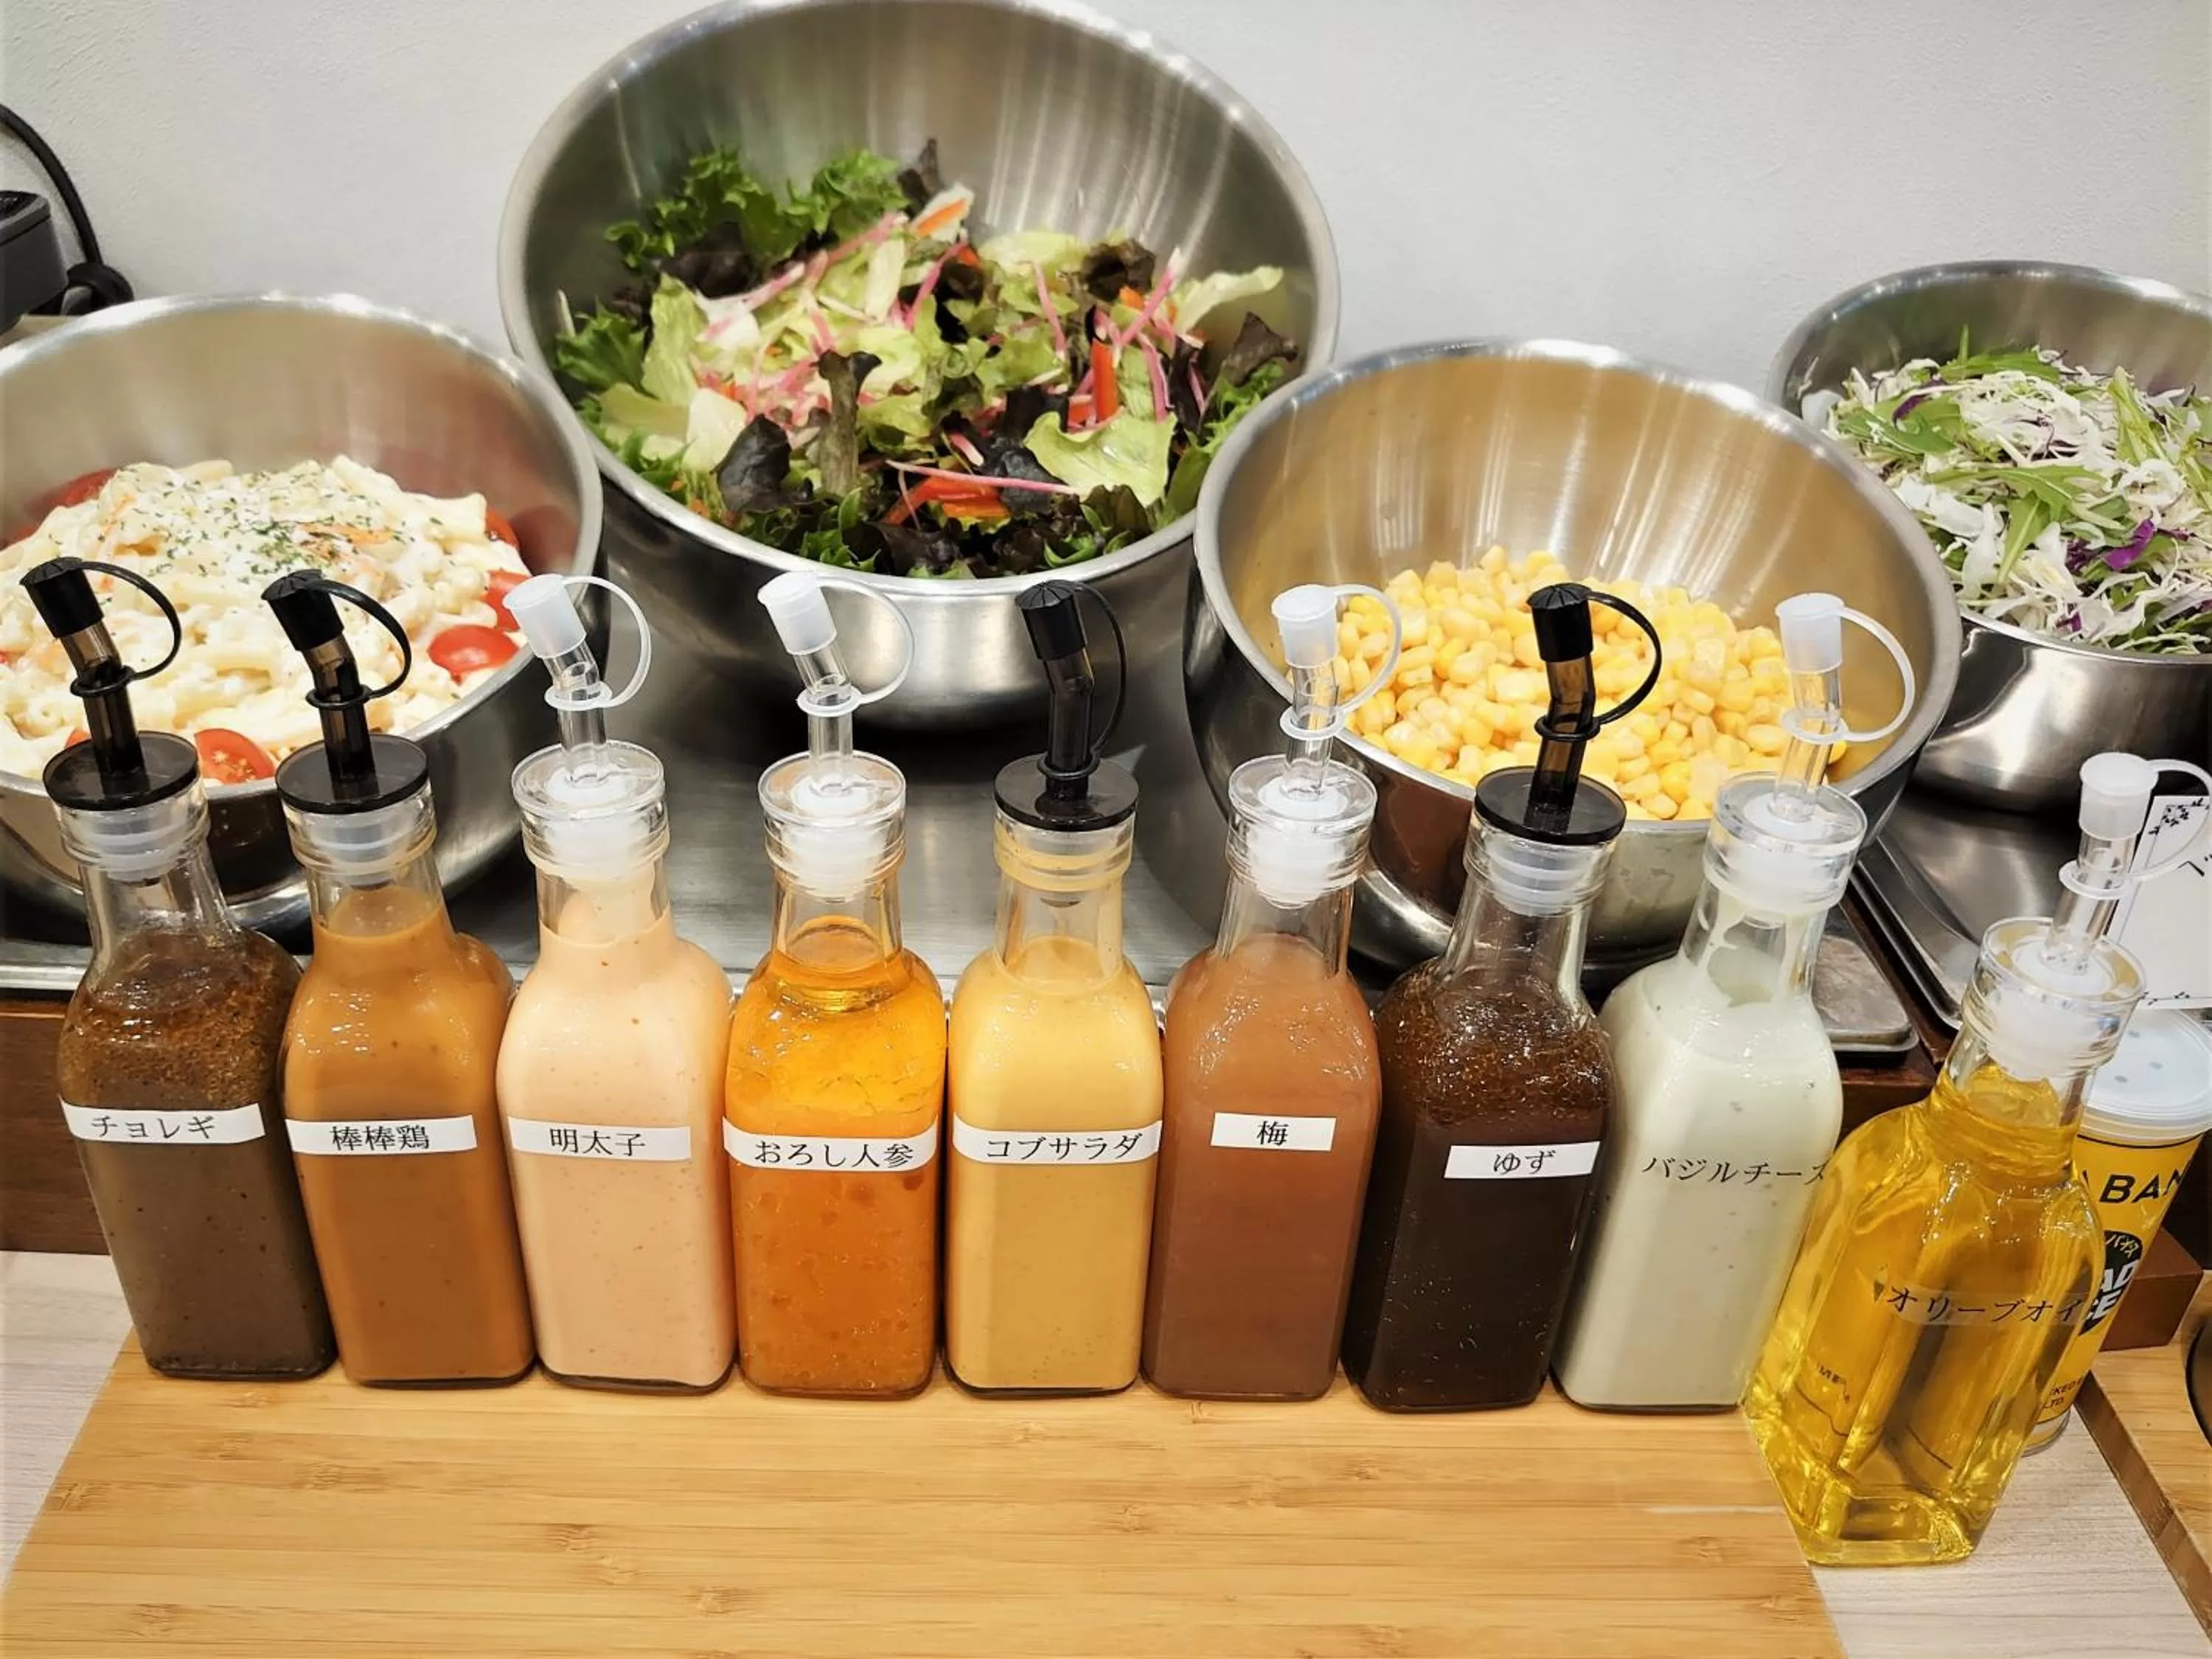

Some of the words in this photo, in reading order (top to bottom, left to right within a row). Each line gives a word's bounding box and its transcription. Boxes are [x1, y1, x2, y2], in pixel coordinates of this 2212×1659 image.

[91, 1115, 216, 1139] チョレギ
[333, 1125, 430, 1151] 棒棒鶏
[1256, 1120, 1288, 1147] 梅
[549, 1127, 646, 1157] 明太子
[754, 1140, 914, 1169] おろし人参
[987, 1132, 1143, 1160] コブサラダ
[1493, 1149, 1556, 1174] ゆず
